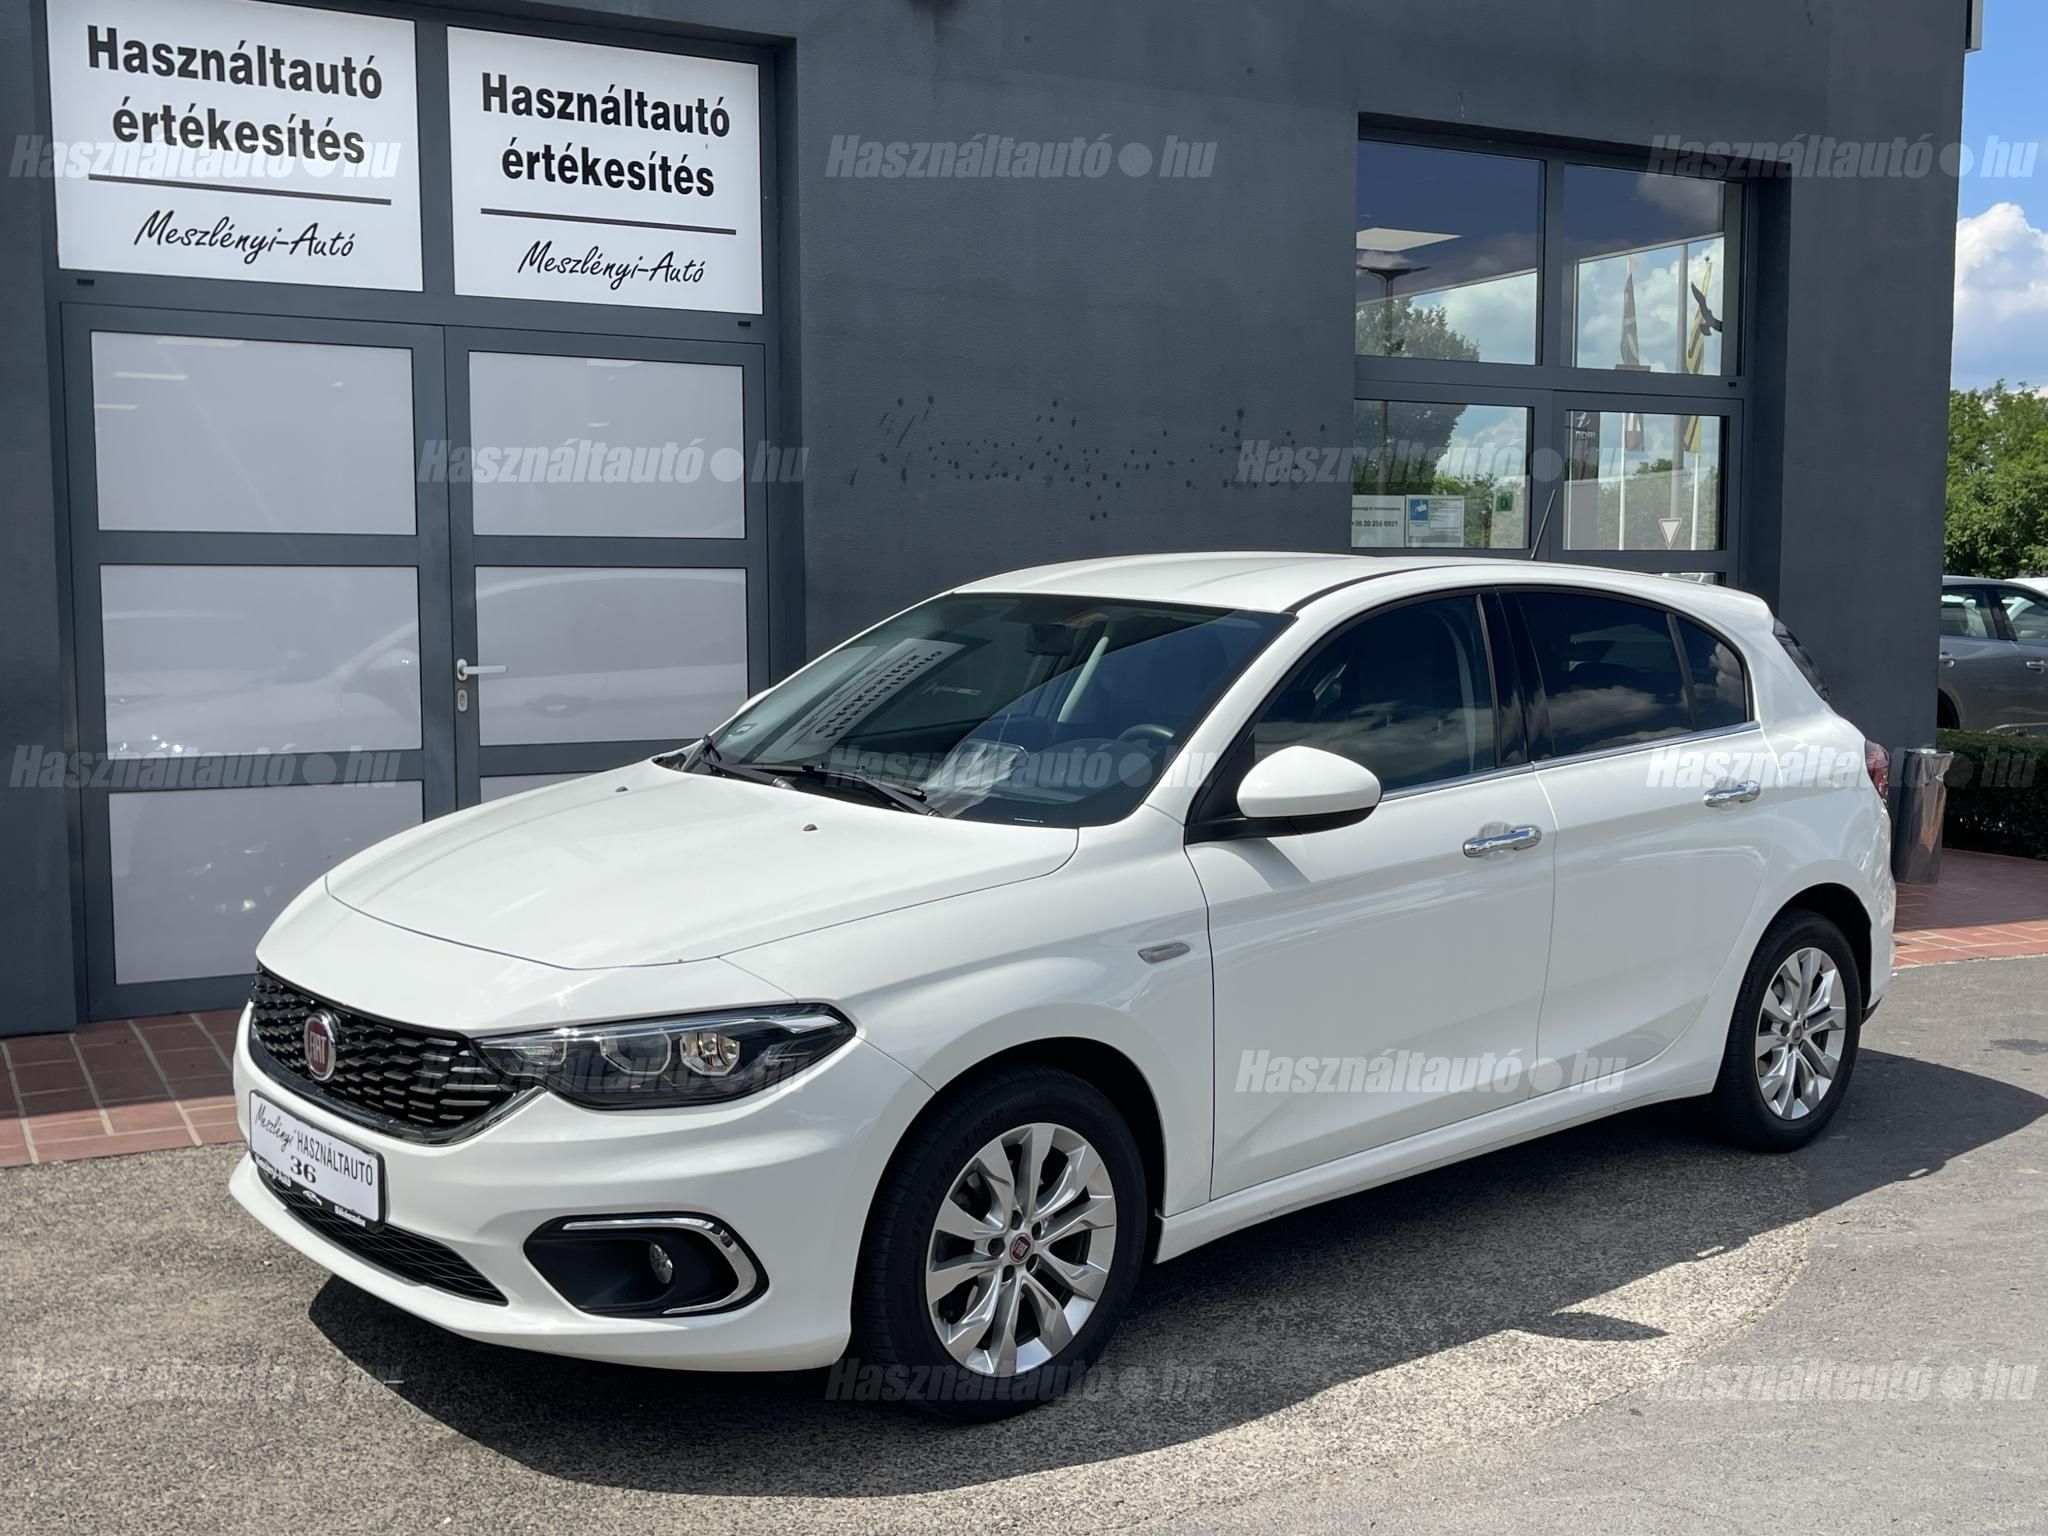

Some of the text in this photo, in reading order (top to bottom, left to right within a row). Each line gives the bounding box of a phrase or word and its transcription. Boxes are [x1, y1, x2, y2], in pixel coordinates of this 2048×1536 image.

[87, 24, 383, 99] Használtautó
[112, 95, 365, 164] értékesítés
[481, 71, 730, 138] Használtautó
[502, 136, 715, 198] értékesítés
[133, 209, 355, 265] Meszlényi-Autó
[517, 240, 706, 290] Meszlényi-Autó
[309, 1031, 327, 1065] FIAT
[290, 1156, 317, 1184] 36
[297, 1132, 373, 1186] HASZNÁLTAUTÓ
